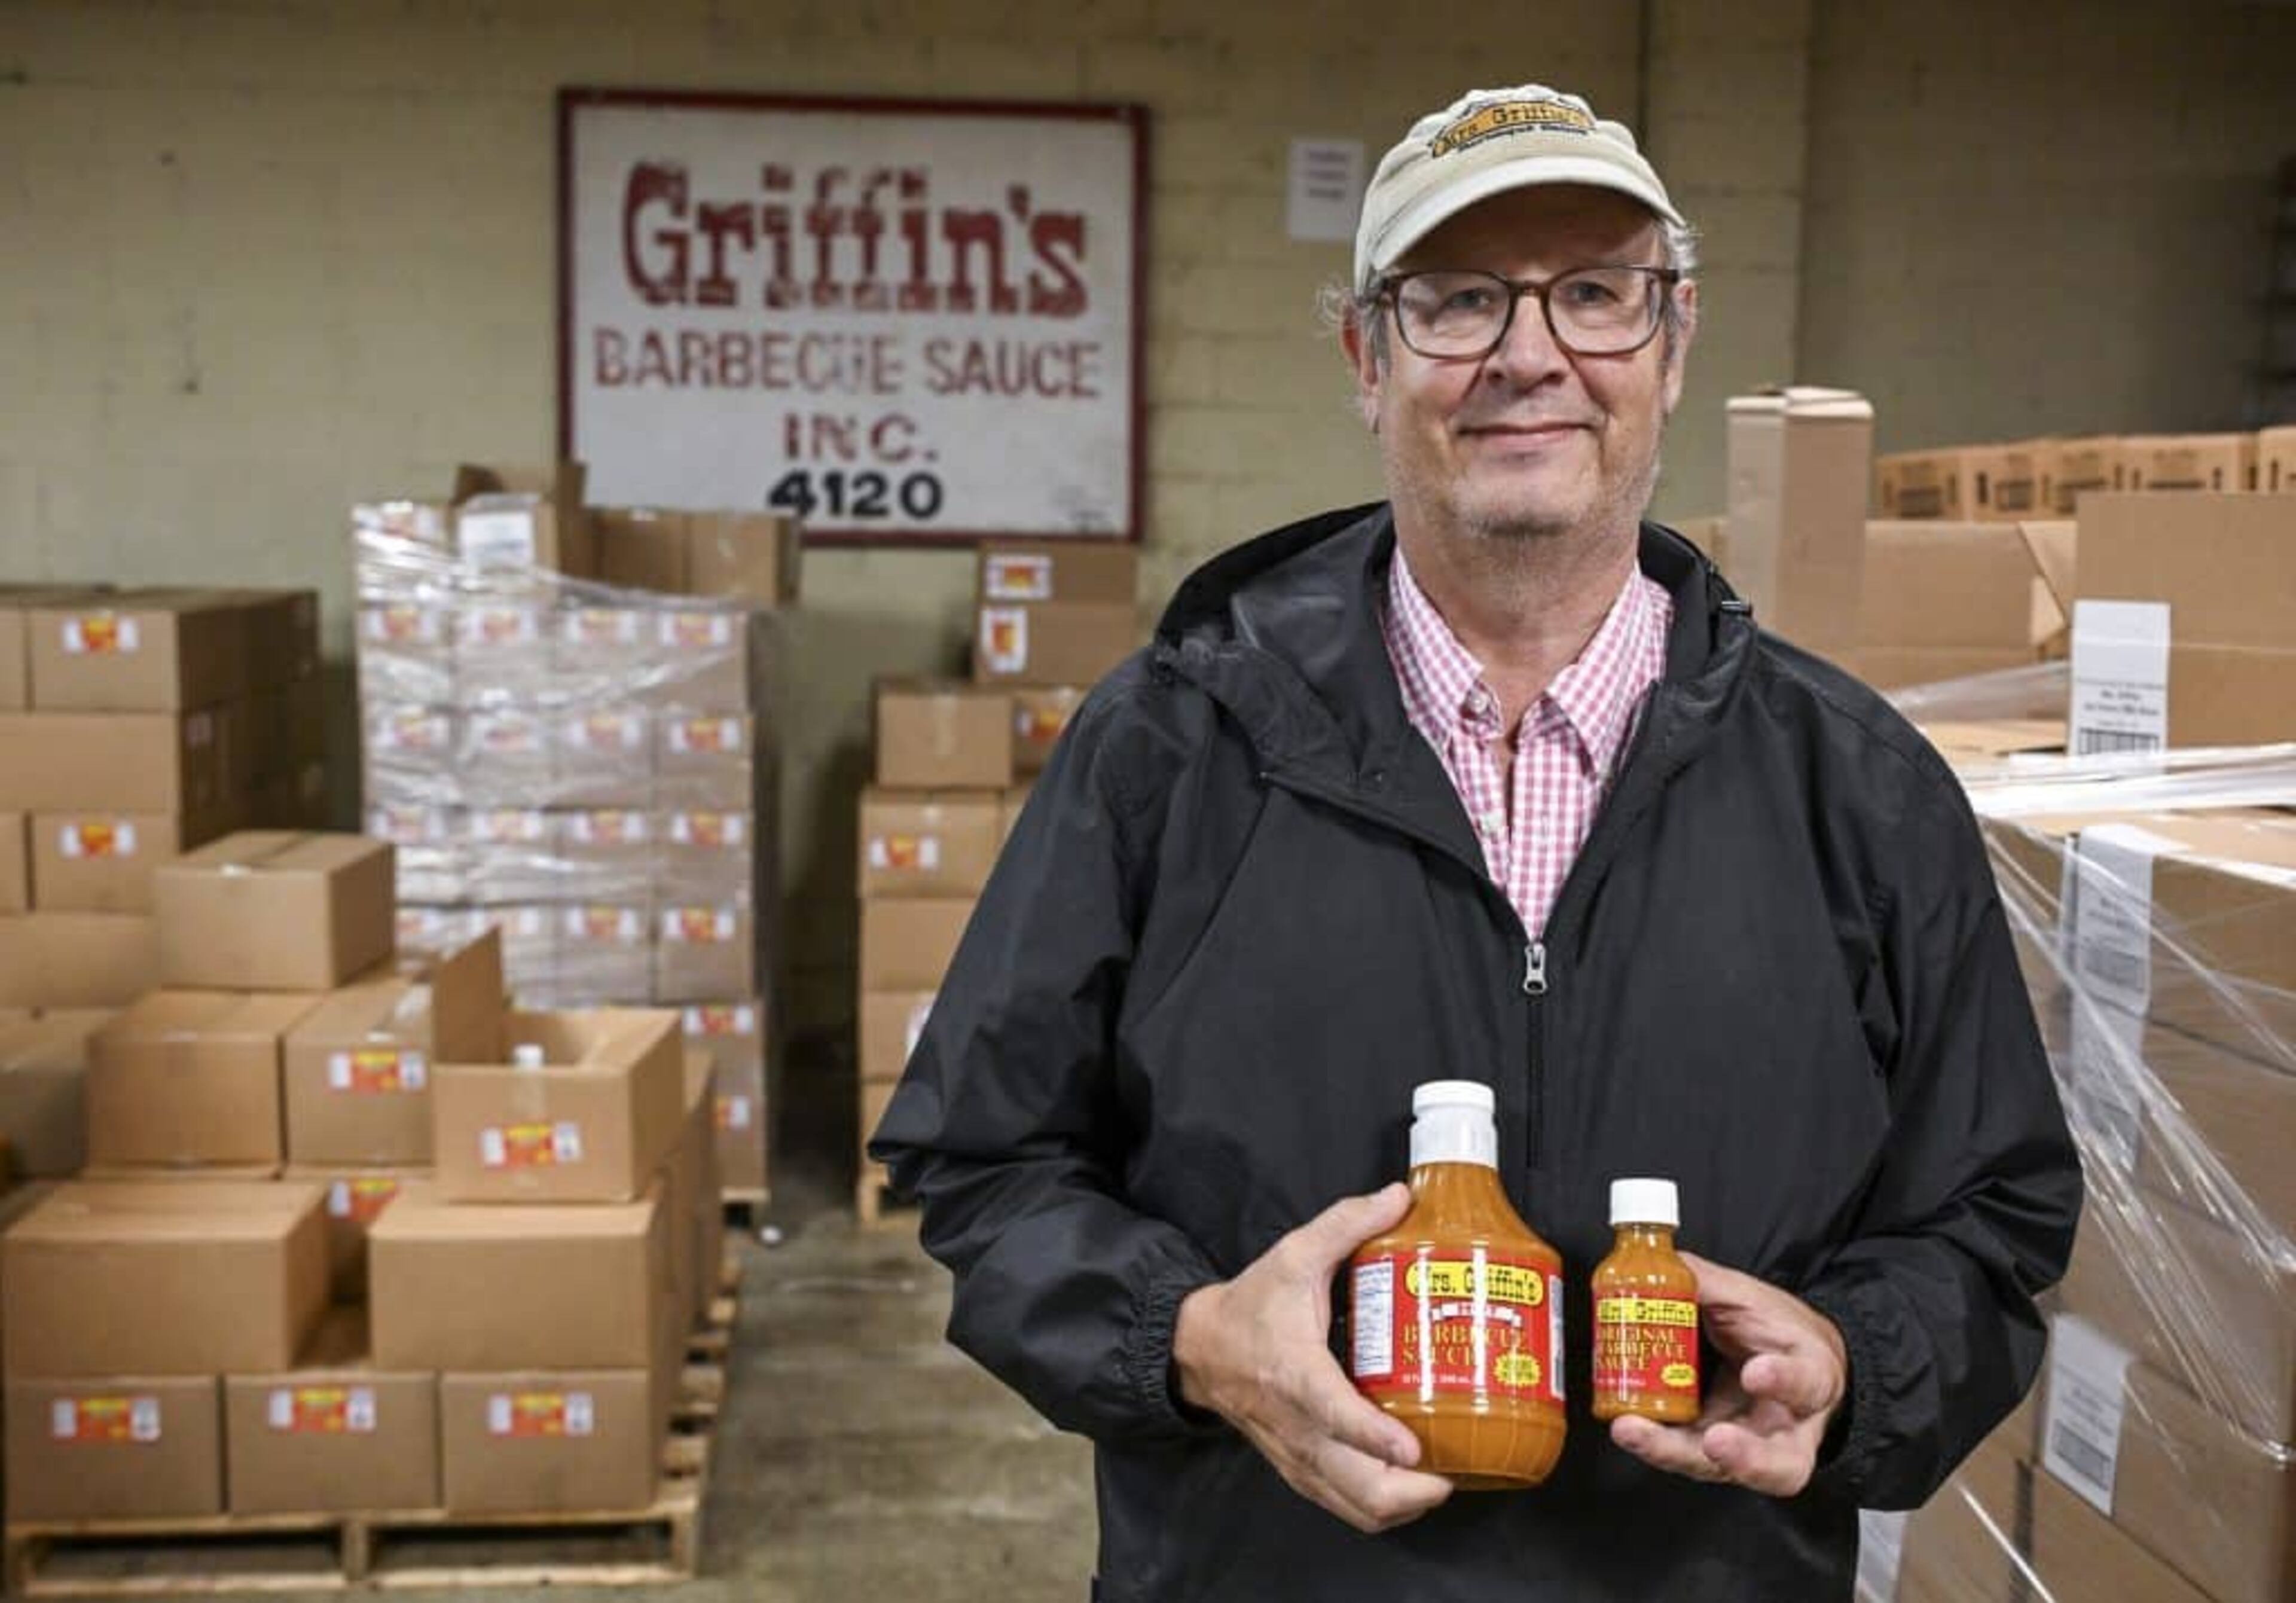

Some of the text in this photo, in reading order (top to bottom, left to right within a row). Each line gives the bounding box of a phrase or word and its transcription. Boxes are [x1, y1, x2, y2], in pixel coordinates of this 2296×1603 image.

[625, 160, 1086, 315] Griffin's
[596, 329, 1100, 397] BARBECUE SAUCE
[784, 413, 939, 463] INC.
[769, 472, 943, 518] 4120
[1464, 1266, 1536, 1302] Giffin's
[1403, 1323, 1526, 1348] BRBCUE
[1403, 1345, 1477, 1367] SUCE
